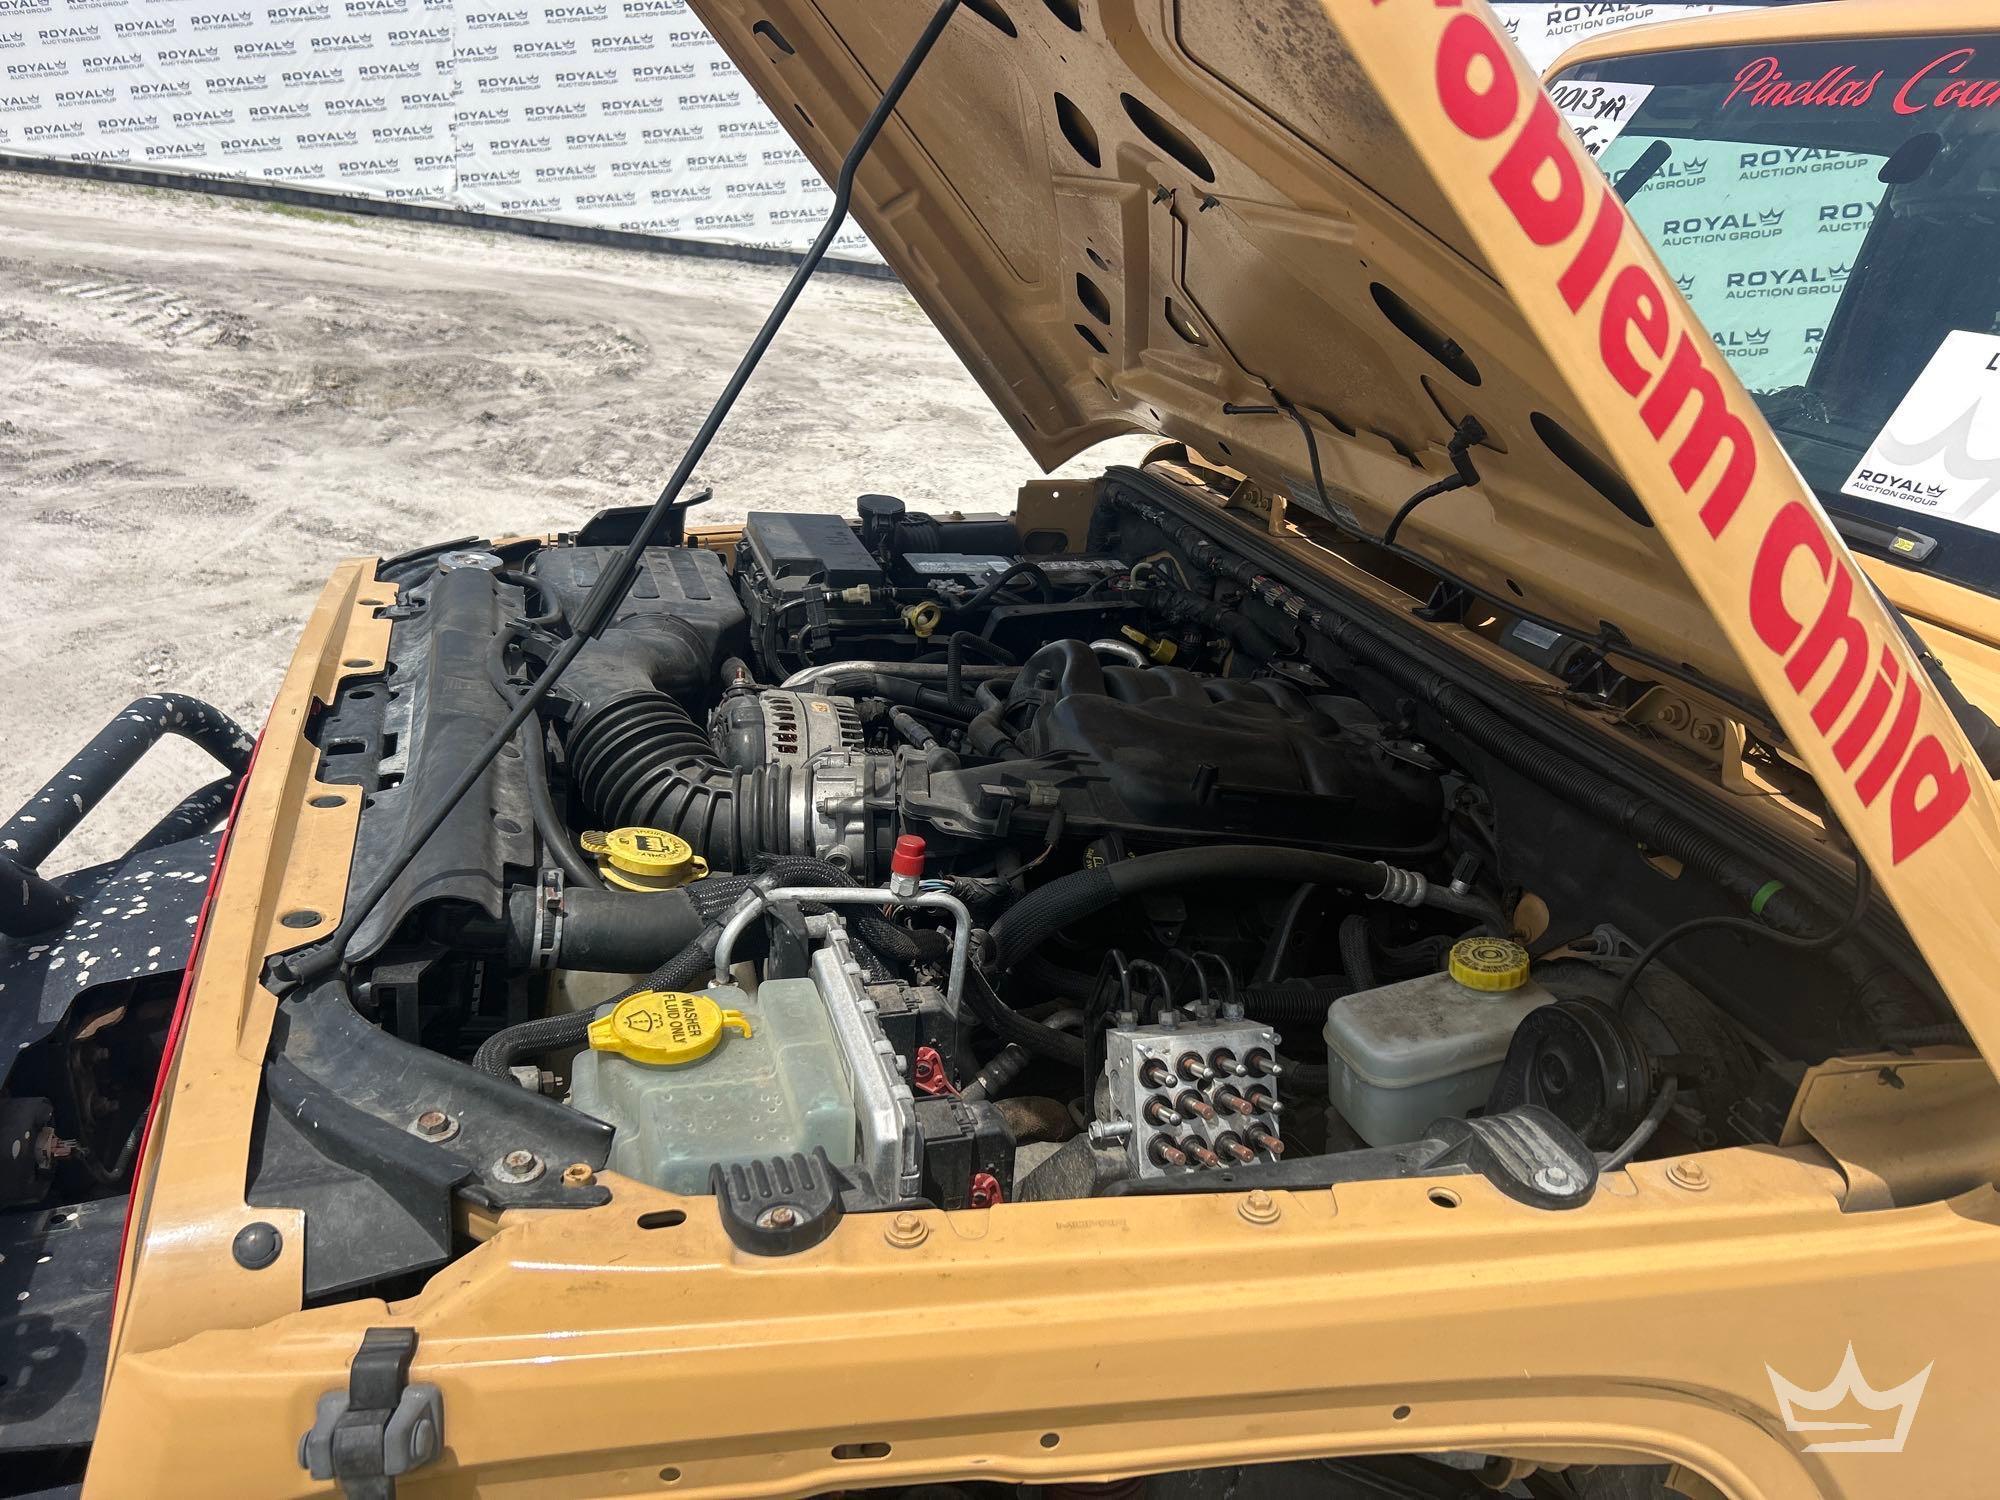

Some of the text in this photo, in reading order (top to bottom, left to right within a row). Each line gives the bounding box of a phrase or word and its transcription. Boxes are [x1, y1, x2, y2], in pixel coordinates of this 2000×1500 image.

[0, 0, 37, 10] OYAL
[346, 0, 394, 11] ROYAL
[622, 1, 671, 12] ROYAL
[268, 7, 316, 18] ROYAL
[466, 12, 515, 23] ROYAL
[545, 6, 593, 18] ROYAL
[191, 13, 239, 25] ROYAL
[1546, 9, 1654, 37] AUCTION GROUP
[114, 20, 162, 32] ROYAL
[39, 27, 87, 39] ROYAL
[388, 29, 436, 40] ROYAL
[669, 31, 709, 42] ROYA
[311, 35, 359, 47] ROYAL
[592, 36, 640, 47] ROYAL
[234, 42, 282, 53] ROYAL
[453, 47, 484, 58] YAL
[514, 41, 562, 53] ROYAL
[158, 49, 206, 60] ROYAL
[82, 55, 130, 67] ROYAL
[7, 62, 55, 74] ROYAL
[359, 64, 407, 75] ROYAL
[633, 65, 681, 76] ROYAL
[282, 70, 330, 81] ROYAL
[555, 71, 604, 82] ROYAL
[206, 76, 254, 88] ROYAL
[478, 76, 526, 87] ROYAL
[1722, 56, 1885, 110] Pinellas
[130, 83, 178, 94] ROYAL
[0, 96, 28, 106] YAL
[55, 90, 103, 101] ROYAL
[678, 93, 727, 105] ROYAL
[325, 98, 373, 110] ROYAL
[601, 99, 650, 110] ROYAL
[249, 105, 297, 116] ROYAL
[455, 108, 496, 121] OYAL
[524, 105, 573, 116] ROYAL
[173, 111, 221, 122] ROYAL
[98, 117, 146, 128] ROYAL
[23, 124, 71, 135] ROYAL
[372, 126, 420, 137] ROYAL
[642, 127, 690, 138] ROYAL
[296, 132, 344, 143] ROYAL
[566, 133, 614, 144] ROYAL
[221, 138, 269, 149] ROYAL
[489, 138, 538, 150] ROYAL
[145, 144, 193, 155] ROYAL
[762, 149, 801, 160] ROYA
[338, 160, 386, 171] ROYAL
[1739, 158, 1868, 181] AUCTION GROUP
[263, 168, 310, 177] ROYAL
[1656, 177, 1706, 190] GROUP
[1819, 201, 1879, 221] ROY
[1663, 213, 1757, 235] ROYAL
[1662, 228, 1783, 246] AUCTION GROUP
[1727, 267, 1825, 288] ROYAL
[1725, 284, 1843, 299] AUCTION GROU
[1721, 347, 1769, 357] ROUP
[1371, 0, 1972, 867] oblem Child
[1858, 469, 1923, 494] ROYAL
[1852, 481, 1938, 507] AUCTION GROUP
[663, 994, 687, 1044] FLUID ONLY
[681, 998, 701, 1037] WASHER
